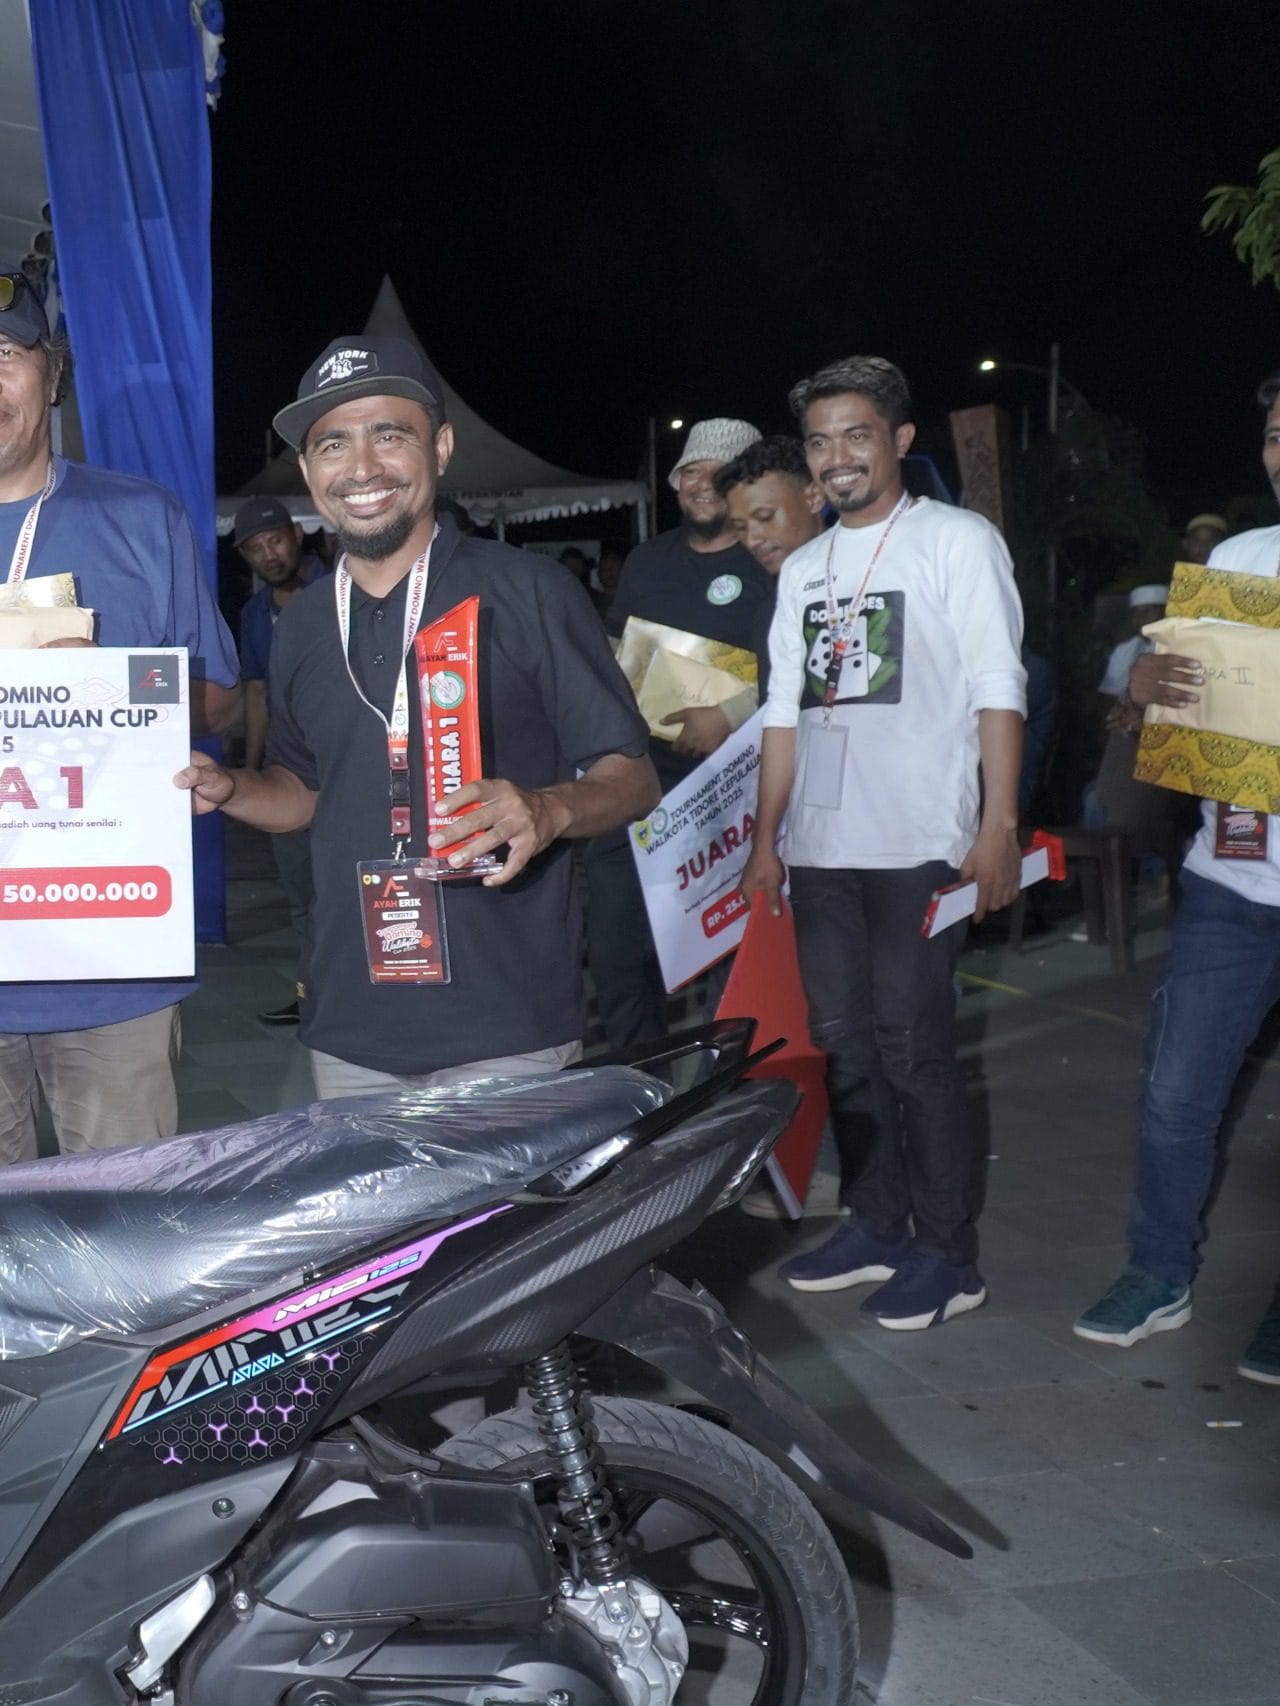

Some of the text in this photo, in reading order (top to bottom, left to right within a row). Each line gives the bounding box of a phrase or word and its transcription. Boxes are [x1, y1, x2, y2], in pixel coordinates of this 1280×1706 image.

[319, 350, 369, 376] NEW YORK
[411, 575, 424, 615] DOMINO
[447, 653, 469, 661] ERIK
[110, 708, 158, 727] CUP
[439, 716, 462, 797] UARA 1
[59, 765, 85, 809] 1
[671, 744, 755, 822] TOURNAMENT DOMINO
[32, 820, 56, 831] uang
[58, 818, 84, 829] tunai
[86, 817, 117, 828] senilai
[646, 754, 762, 855] WALIKOTA TIDORE KEPULAUA
[694, 787, 744, 832] TAHUN 2025
[676, 812, 756, 891] JUARA
[3, 881, 158, 904] 50.000.000
[373, 898, 422, 909] AYAH ERIK
[274, 1251, 421, 1323] MIO 125
